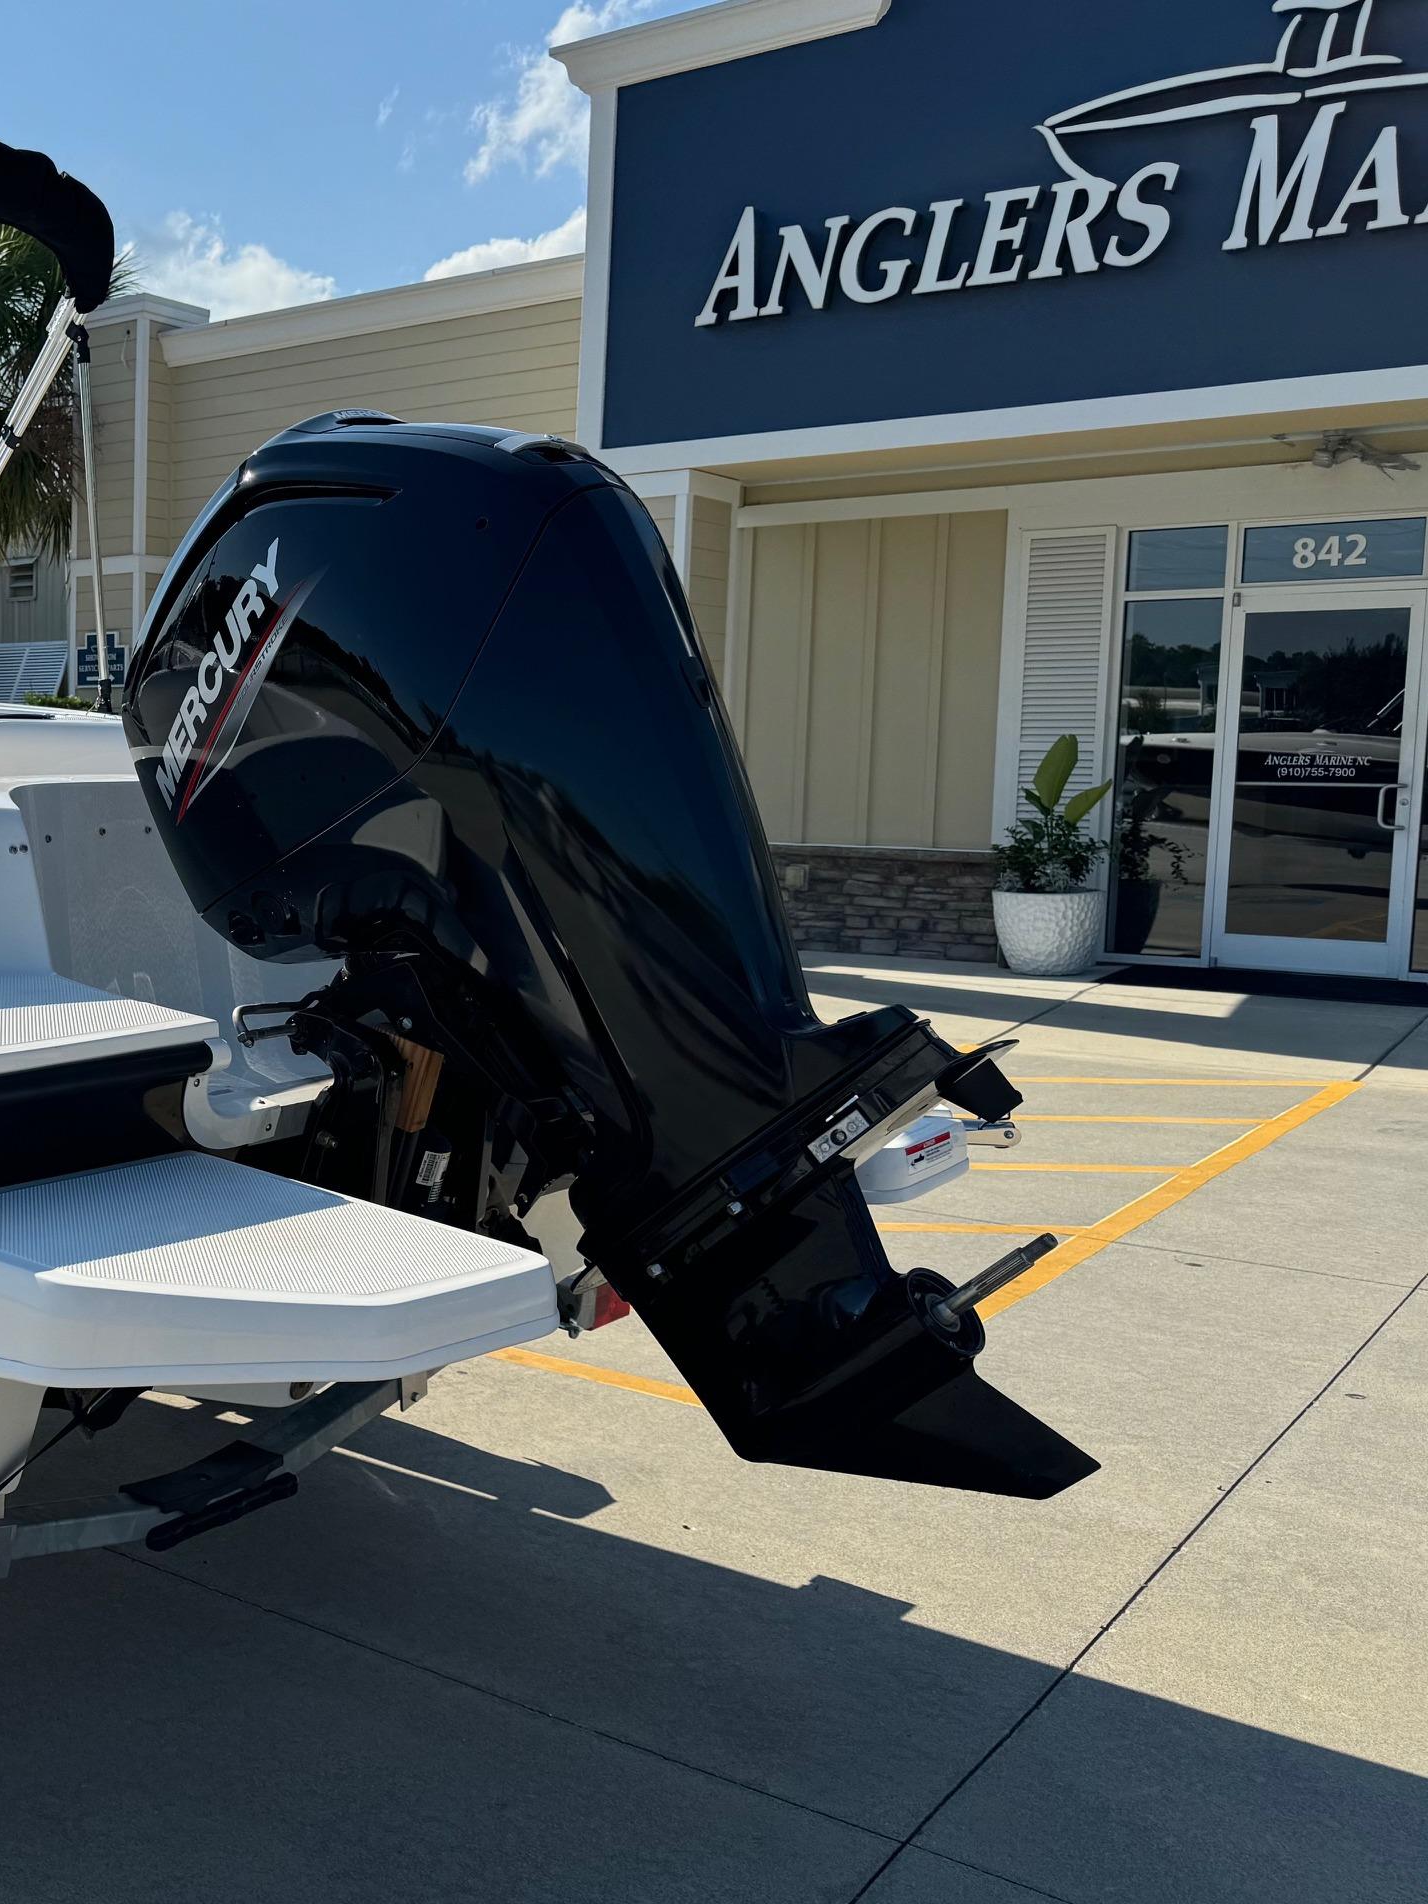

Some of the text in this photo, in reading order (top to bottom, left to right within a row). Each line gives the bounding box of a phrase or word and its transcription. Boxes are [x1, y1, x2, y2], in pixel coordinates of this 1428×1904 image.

[694, 101, 1428, 327] ANGLERS MA
[1292, 533, 1367, 569] 842
[155, 537, 279, 811] MERCURY
[235, 615, 290, 704] FOURSTROKE
[1264, 754, 1372, 766] ANGLERS MARINE NC
[1277, 767, 1356, 779] (910)755-7900
